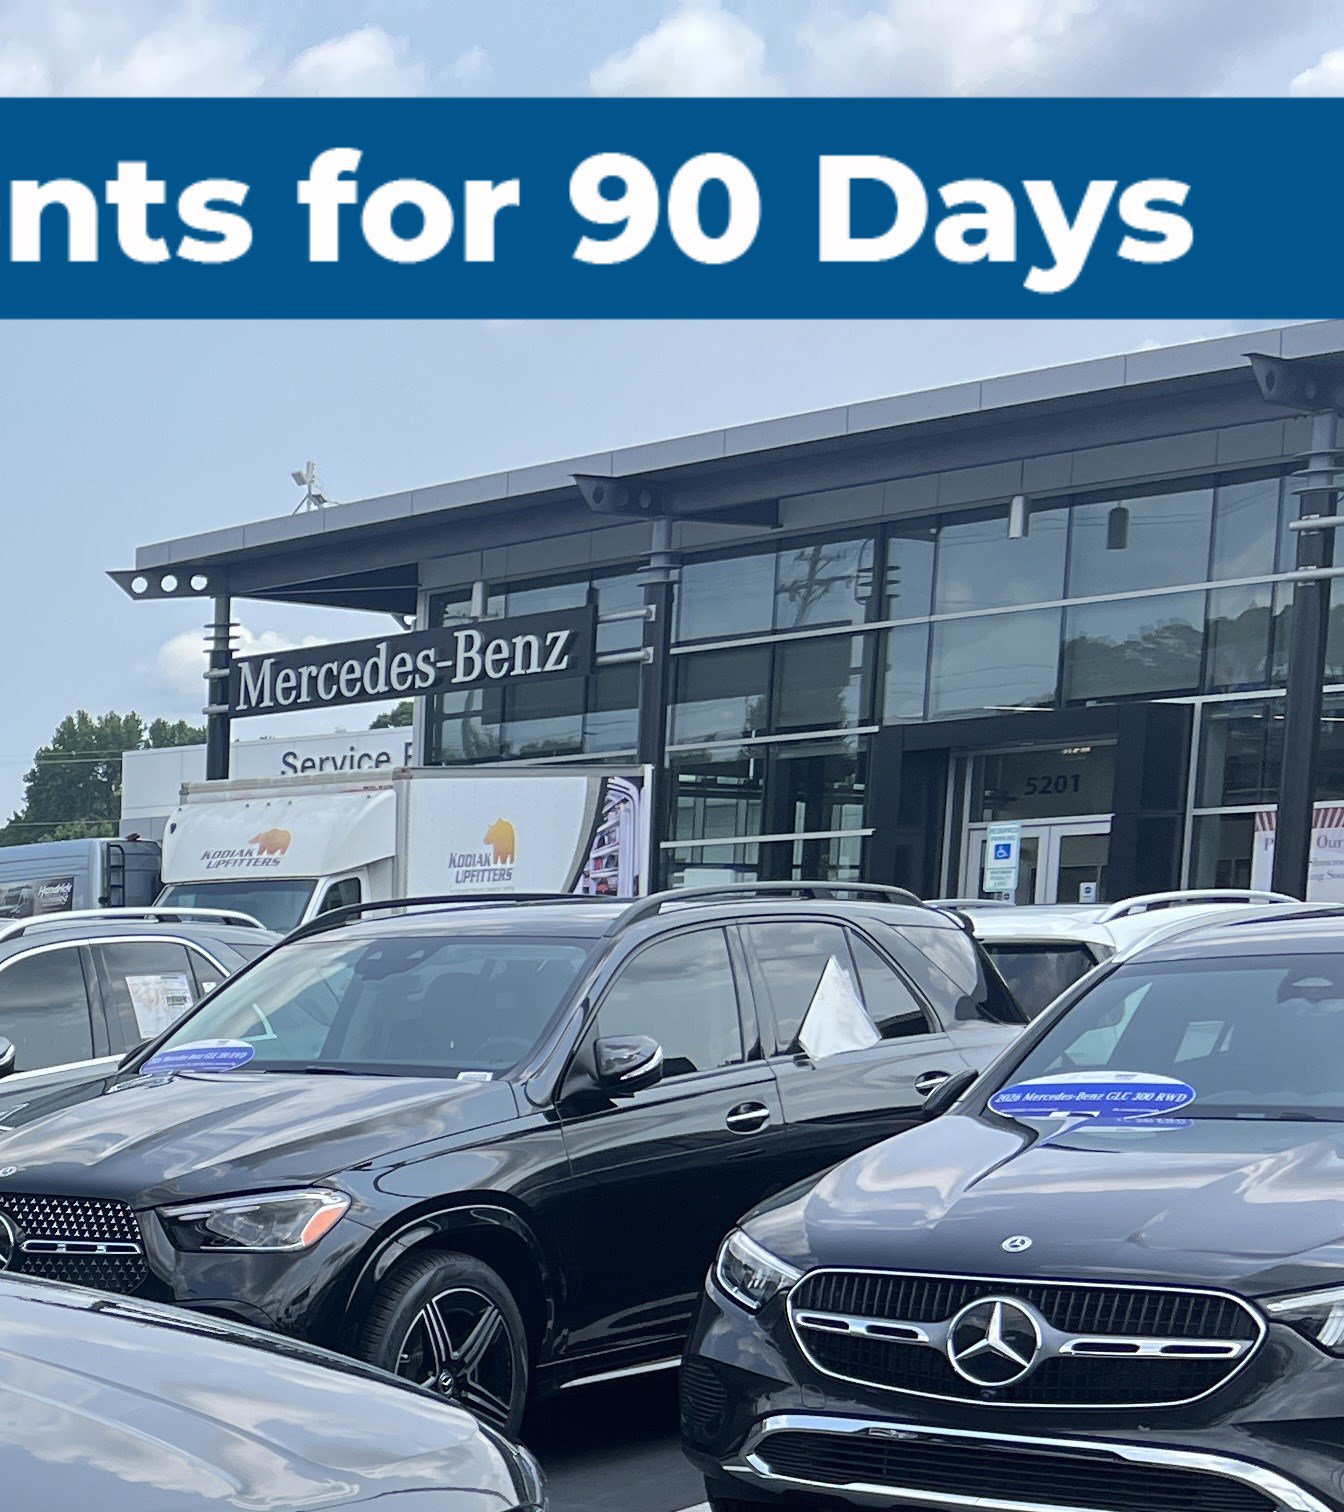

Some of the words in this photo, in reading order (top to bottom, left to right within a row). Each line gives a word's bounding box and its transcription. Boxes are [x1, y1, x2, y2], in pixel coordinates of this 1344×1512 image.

[236, 629, 571, 711] Mercedes-Benz
[281, 746, 391, 775] Service
[1025, 773, 1082, 795] 5201
[200, 848, 255, 860] KODIAK
[448, 853, 491, 868] KODIAK
[206, 858, 281, 869] UPFITTERS
[455, 868, 513, 883] UPFITTERS
[1022, 1091, 1104, 1102] Mercedes-Benz
[1155, 1092, 1187, 1102] RWD
